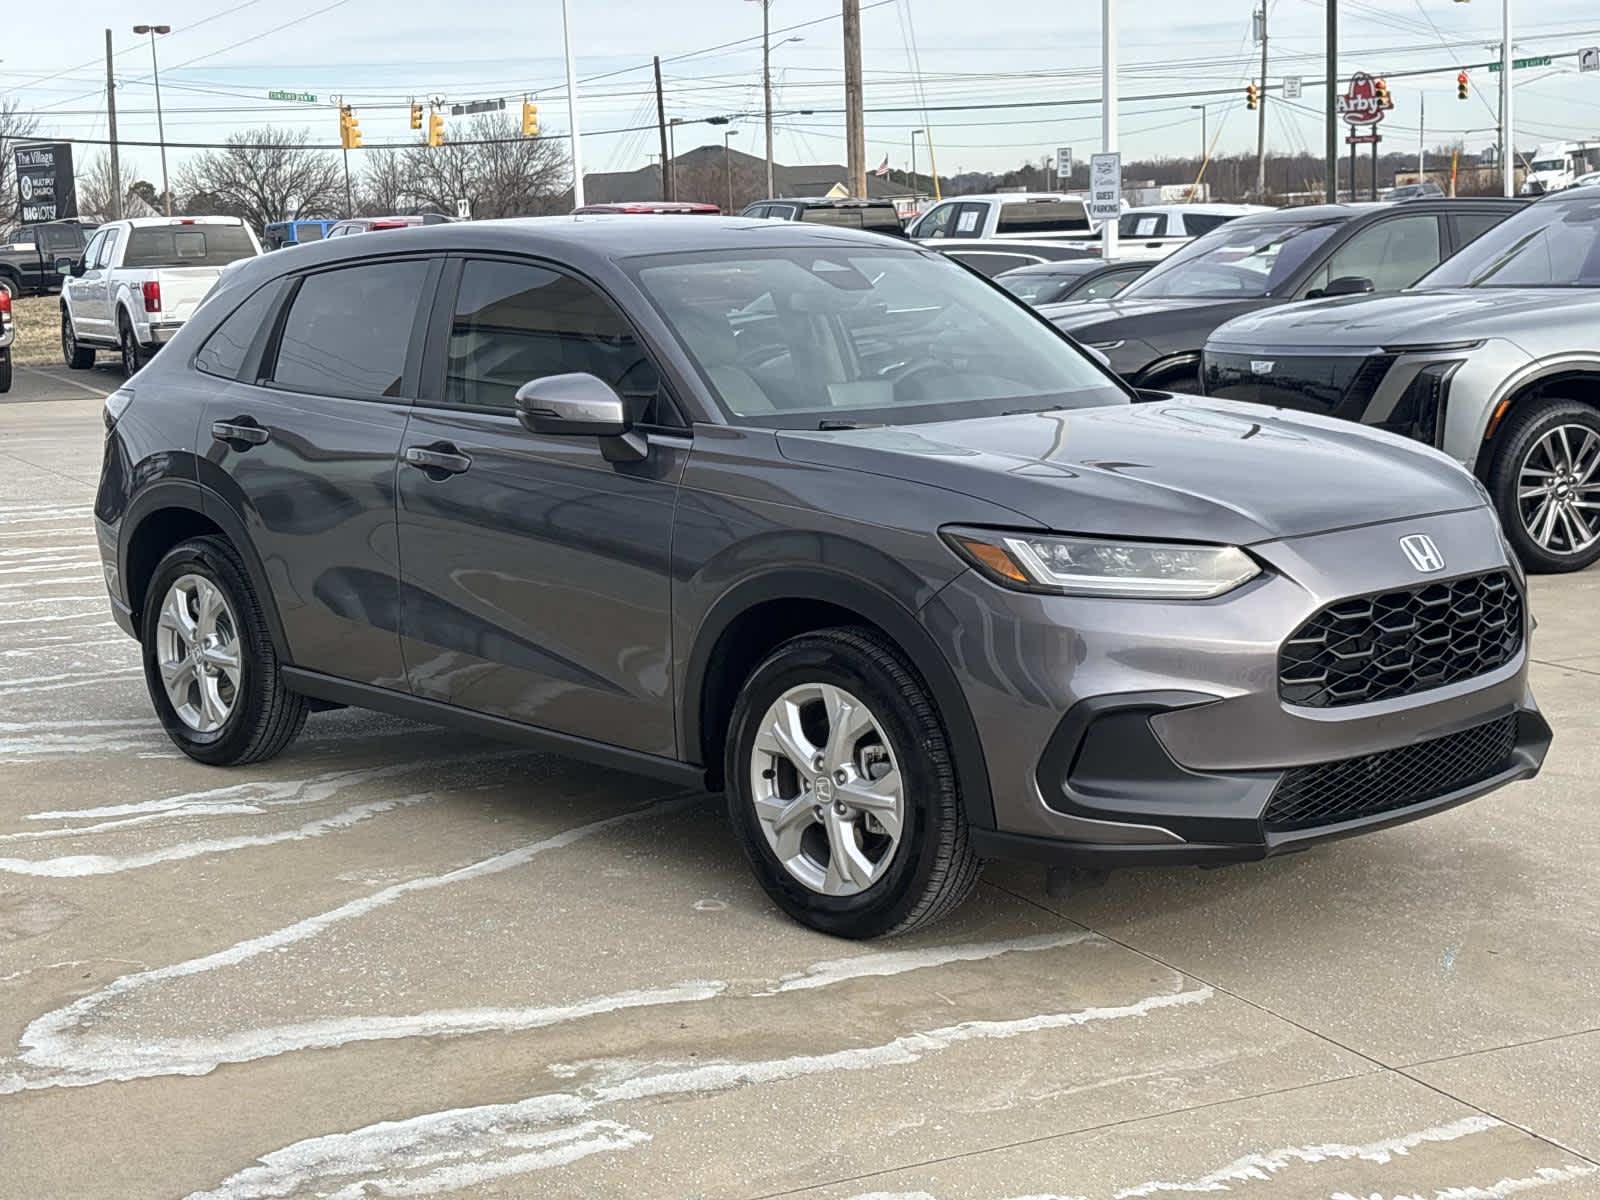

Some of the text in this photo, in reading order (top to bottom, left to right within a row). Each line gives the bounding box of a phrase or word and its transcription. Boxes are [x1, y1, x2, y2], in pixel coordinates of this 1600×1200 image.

[16, 151, 53, 167] The Village
[32, 178, 55, 186] MULTIPLY
[33, 187, 54, 196] CHURCH
[1096, 191, 1114, 200] GUEST
[1093, 204, 1118, 214] PARKING
